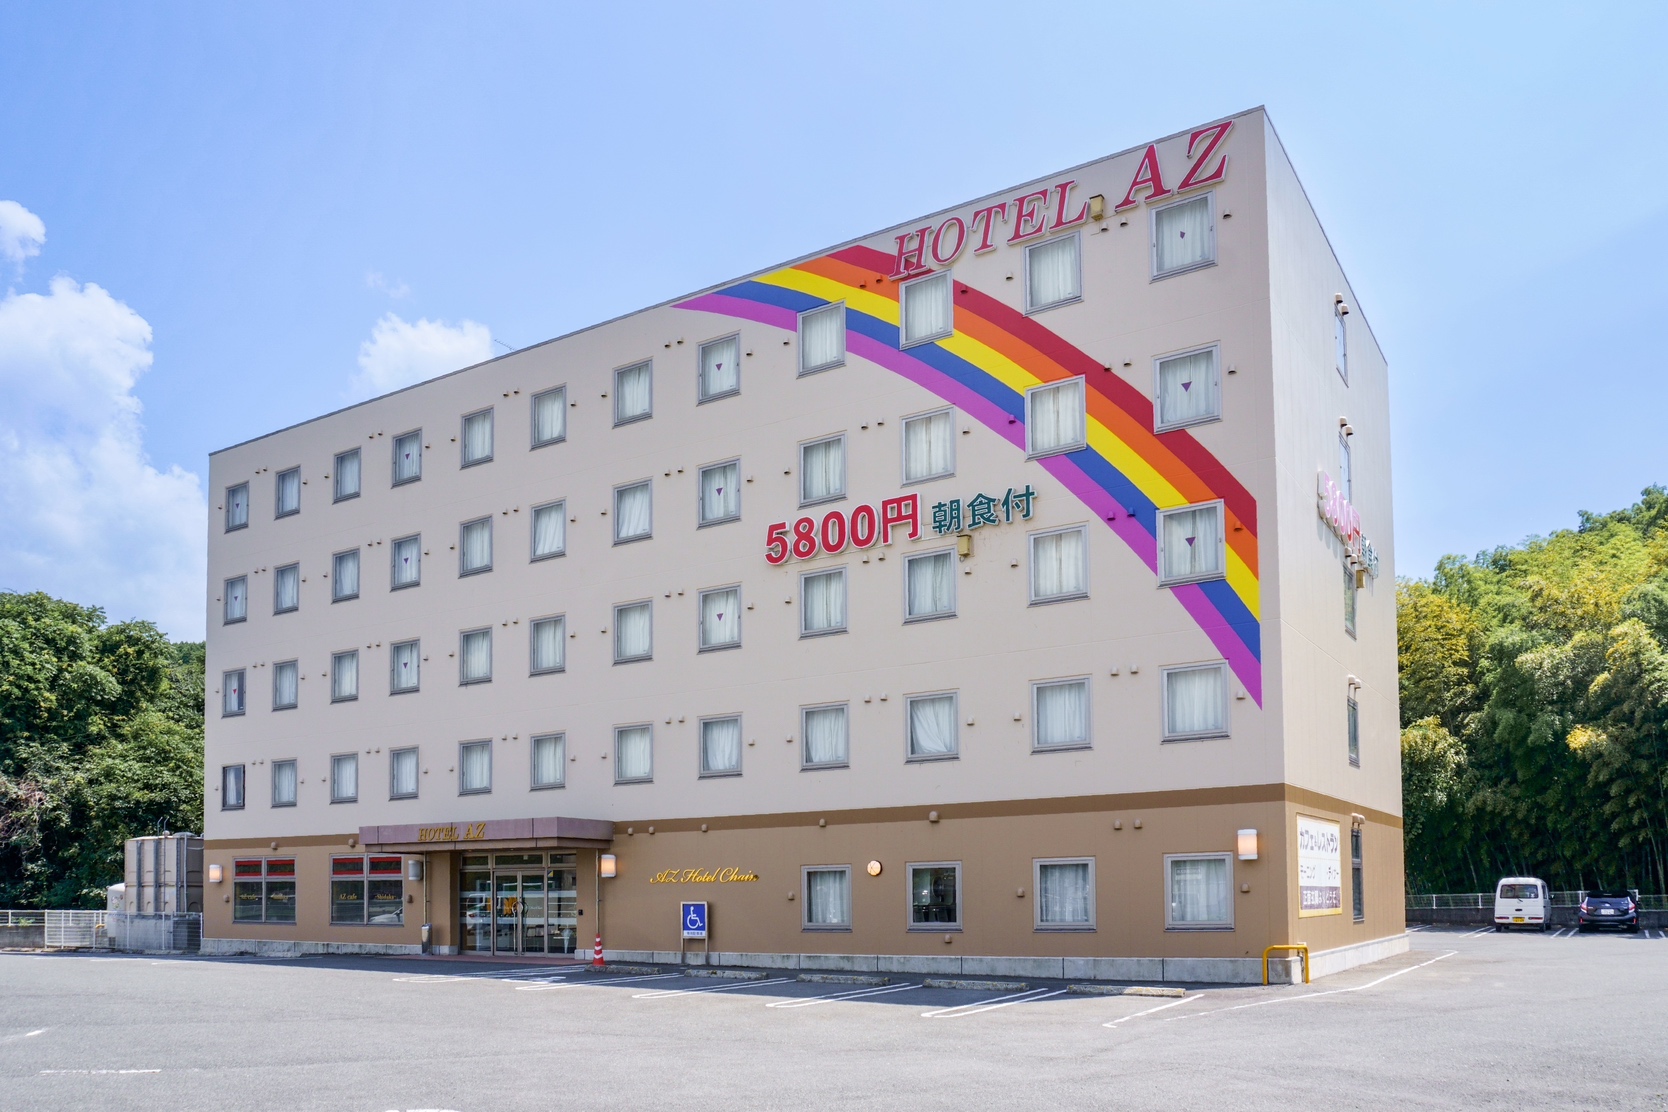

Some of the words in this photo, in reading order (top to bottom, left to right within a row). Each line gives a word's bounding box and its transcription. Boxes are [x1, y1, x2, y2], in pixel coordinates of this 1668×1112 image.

[888, 179, 1090, 281] HOTEL
[1114, 119, 1235, 213] AZ
[764, 492, 923, 566] 5800円
[931, 484, 1037, 535] 朝食付
[418, 826, 459, 842] HOTEL
[463, 823, 486, 840] AZ
[649, 868, 680, 884] AZ
[680, 867, 721, 884] Hotel
[719, 867, 759, 883] Chain
